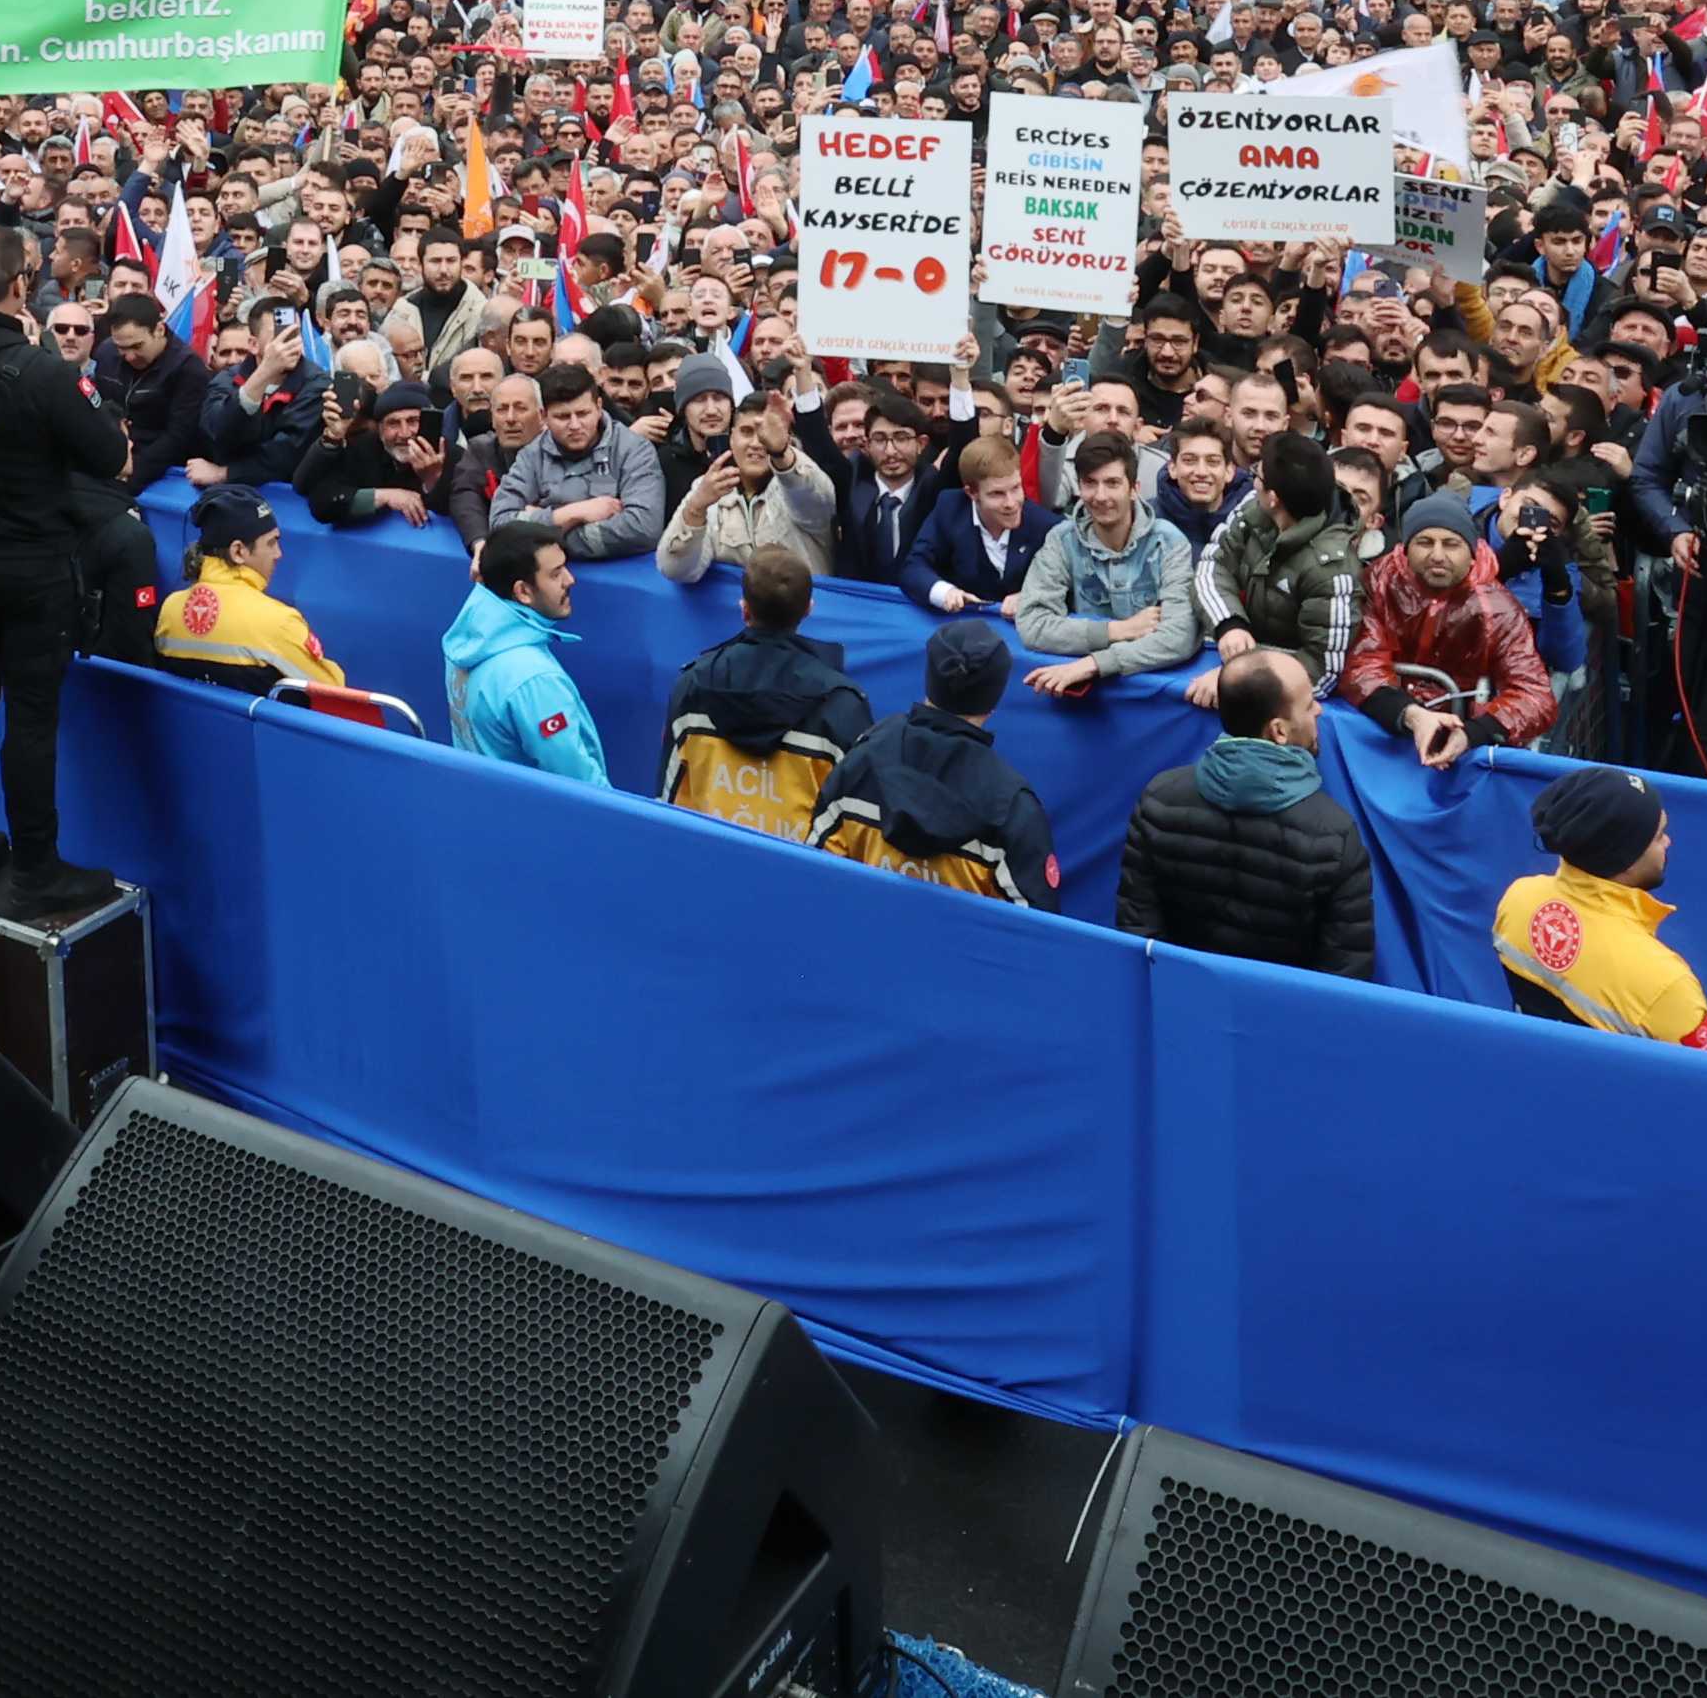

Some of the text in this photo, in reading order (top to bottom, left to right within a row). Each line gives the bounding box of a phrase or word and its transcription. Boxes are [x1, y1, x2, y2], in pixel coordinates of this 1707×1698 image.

[39, 28, 326, 66] Cumhurbaşkanım
[1177, 105, 1381, 135] ÖZENİYORLAR
[818, 131, 942, 162] HEDEF
[1015, 126, 1111, 150] ERCİYES
[1028, 150, 1104, 172] GİBİSİN
[1238, 144, 1320, 170] AMA
[834, 174, 915, 199] BELLİ
[995, 170, 1132, 196] REİS NEREDEN
[1179, 178, 1381, 205] ÇÖZEMİYORLAR
[1024, 196, 1100, 221] BAKSAK
[1032, 226, 1086, 247] SENİ
[988, 242, 1128, 272] GÖRÜYORUZ
[712, 761, 784, 803] ACİL
